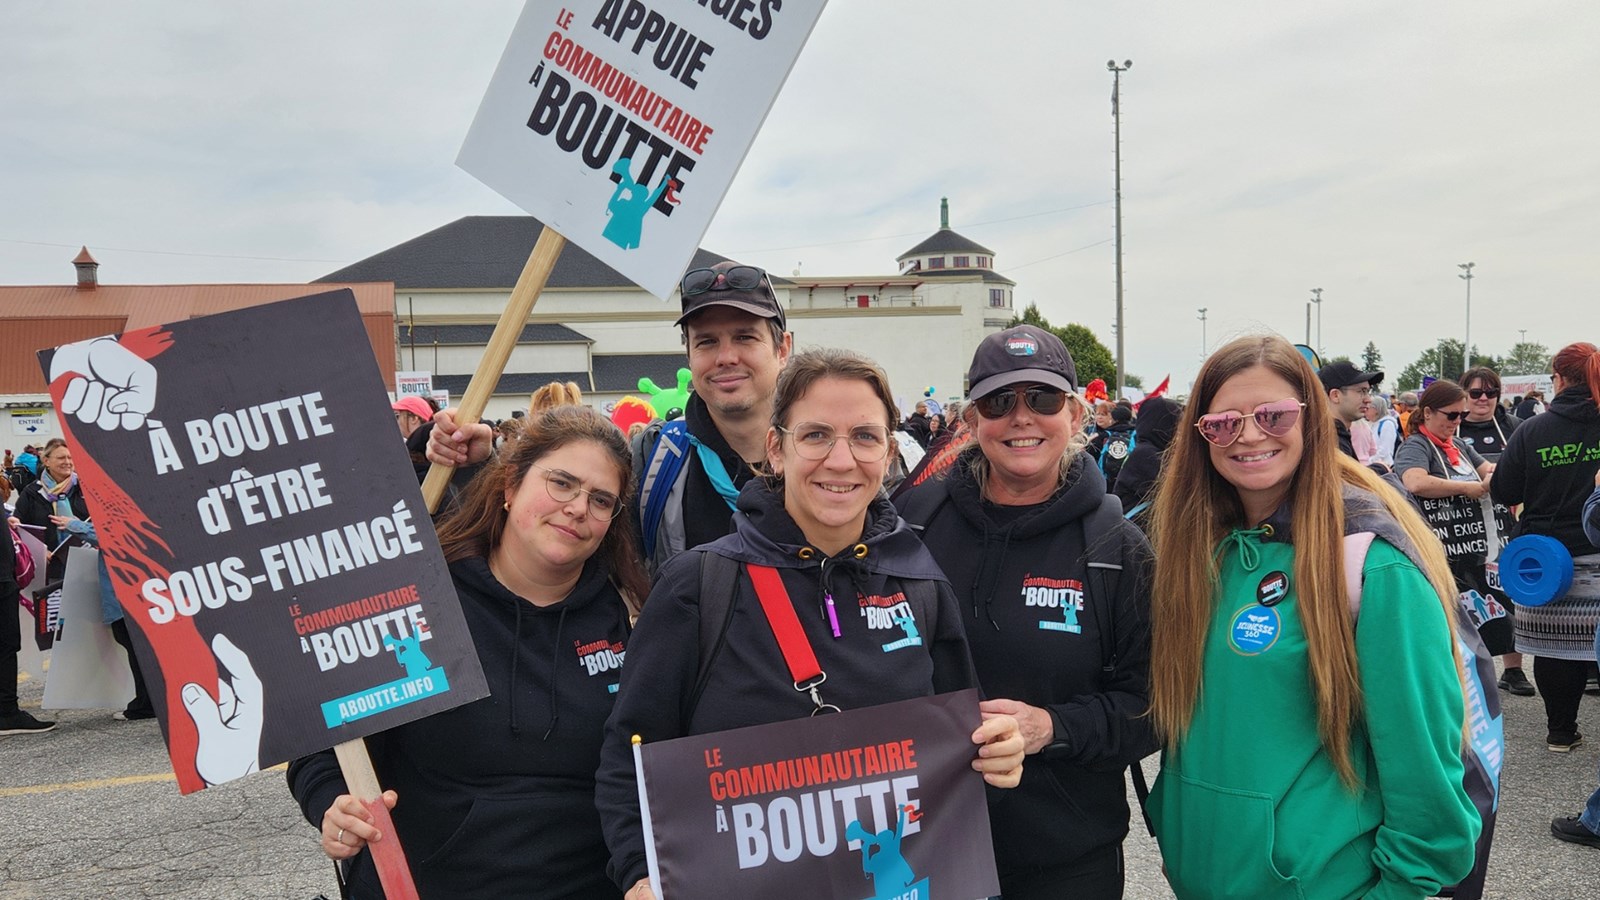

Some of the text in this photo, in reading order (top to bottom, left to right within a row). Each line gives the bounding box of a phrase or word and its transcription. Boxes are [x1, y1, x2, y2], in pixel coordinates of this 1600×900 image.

[556, 8, 574, 31] LE
[592, 0, 714, 90] APPUIE
[543, 31, 714, 155] COMMUNAUTAIRE
[526, 60, 696, 217] À BOUTTE
[146, 391, 334, 475] À BOUTTE
[197, 462, 333, 536] d'ÊTRE
[1428, 507, 1473, 524] MAUVAIS
[1453, 521, 1485, 538] EXIGE
[141, 499, 423, 625] SOUS-FINANCÉ
[288, 603, 301, 617] LE
[294, 584, 420, 636] COMMUNAUTAIRE
[1025, 587, 1084, 611] BOUTTE
[300, 604, 433, 672] À BOUTTE
[1237, 622, 1274, 635] JEUNESSE
[338, 676, 434, 719] ABOUTTE.INFO
[704, 748, 723, 769] LE
[709, 739, 917, 801] COMMUNAUTAIRE
[715, 775, 921, 869] À BOUTTE
